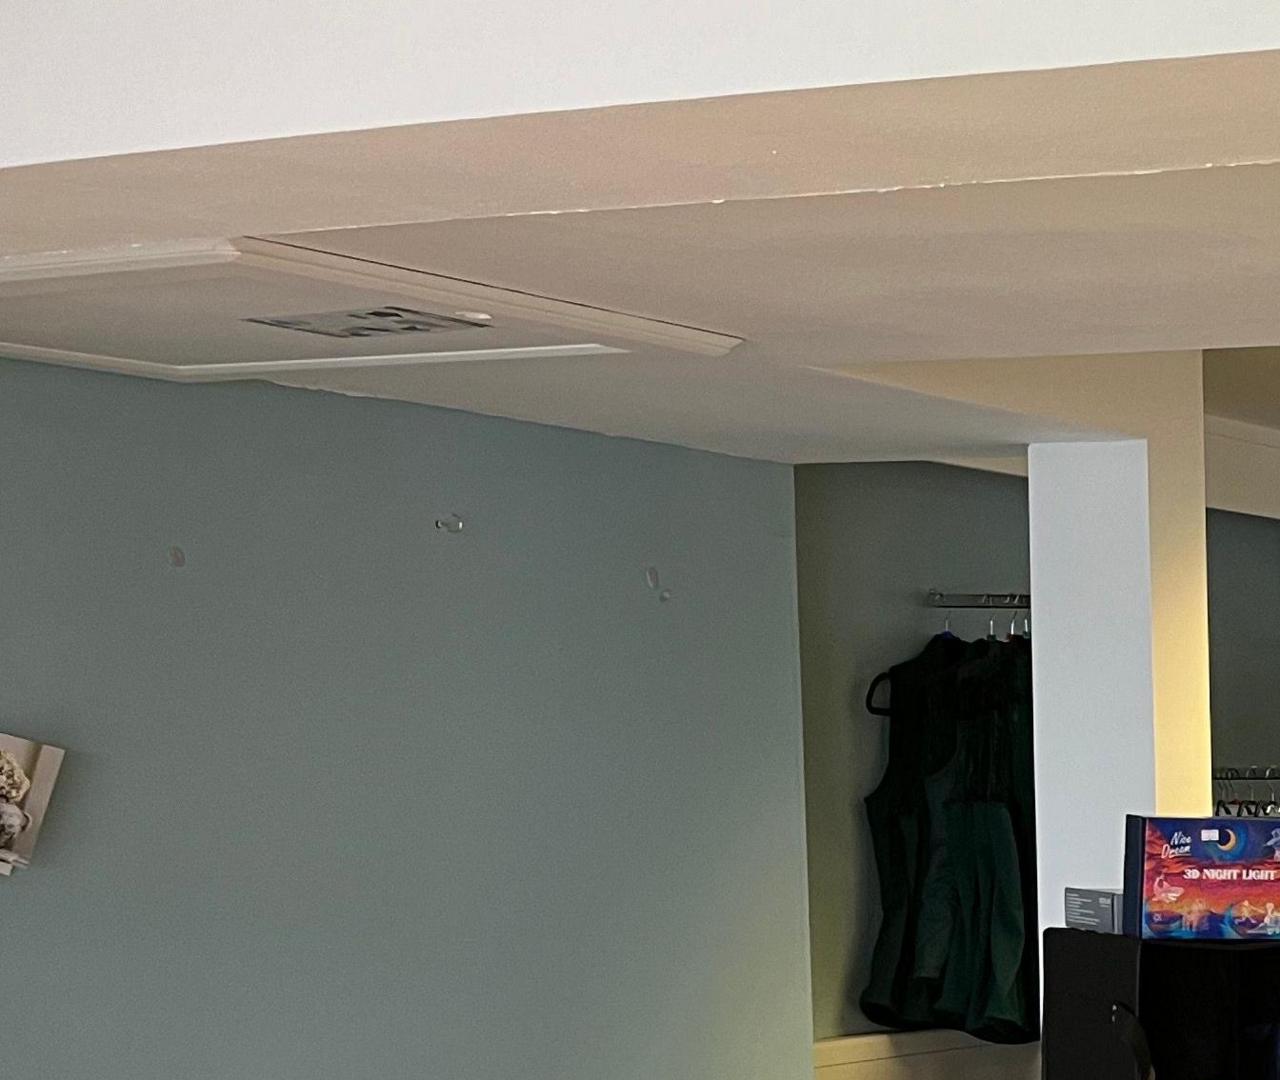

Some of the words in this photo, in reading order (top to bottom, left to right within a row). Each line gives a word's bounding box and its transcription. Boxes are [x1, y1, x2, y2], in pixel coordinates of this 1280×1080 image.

[1170, 832, 1192, 846] Nice
[1183, 868, 1201, 880] 3D
[1202, 868, 1241, 881] NIGHT
[1242, 868, 1278, 881] LIGHT
